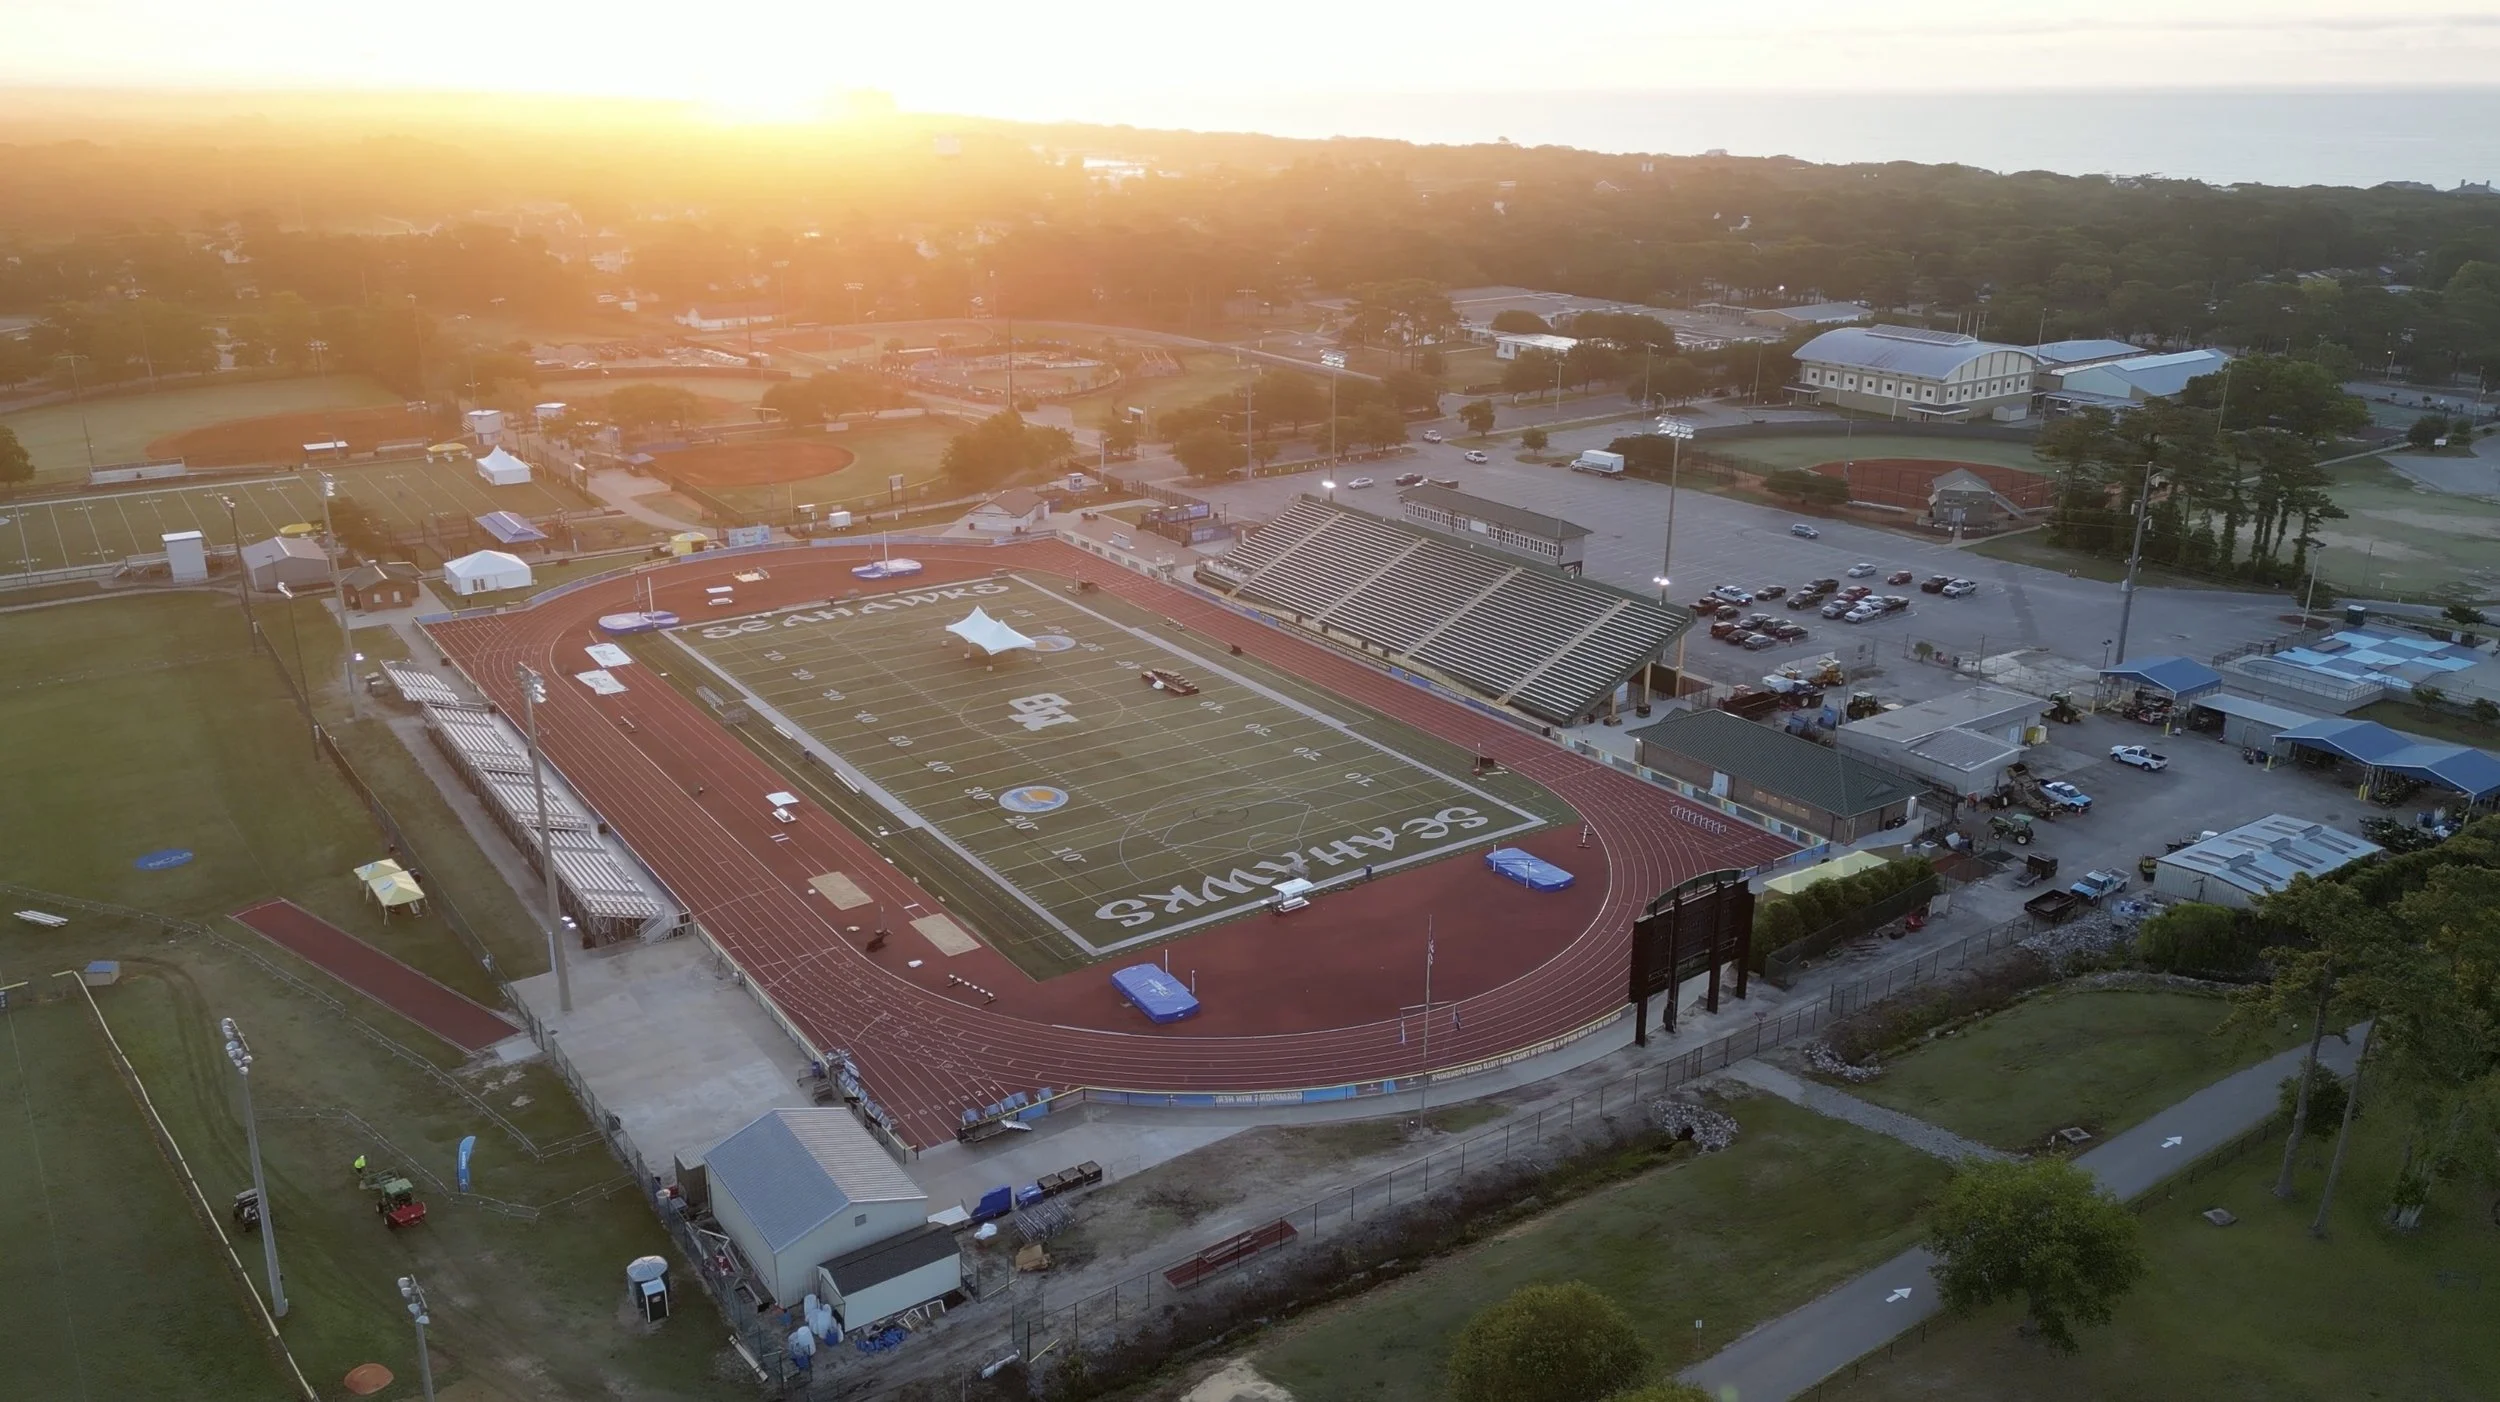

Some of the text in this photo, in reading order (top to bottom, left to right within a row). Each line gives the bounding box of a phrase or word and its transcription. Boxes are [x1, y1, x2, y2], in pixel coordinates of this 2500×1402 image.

[701, 583, 1010, 640] SEAHAWKS
[926, 760, 952, 773] 40
[964, 786, 990, 800] 30
[1005, 815, 1034, 830] 20
[1052, 847, 1081, 862] 10
[1094, 806, 1490, 928] SEAHAWKS
